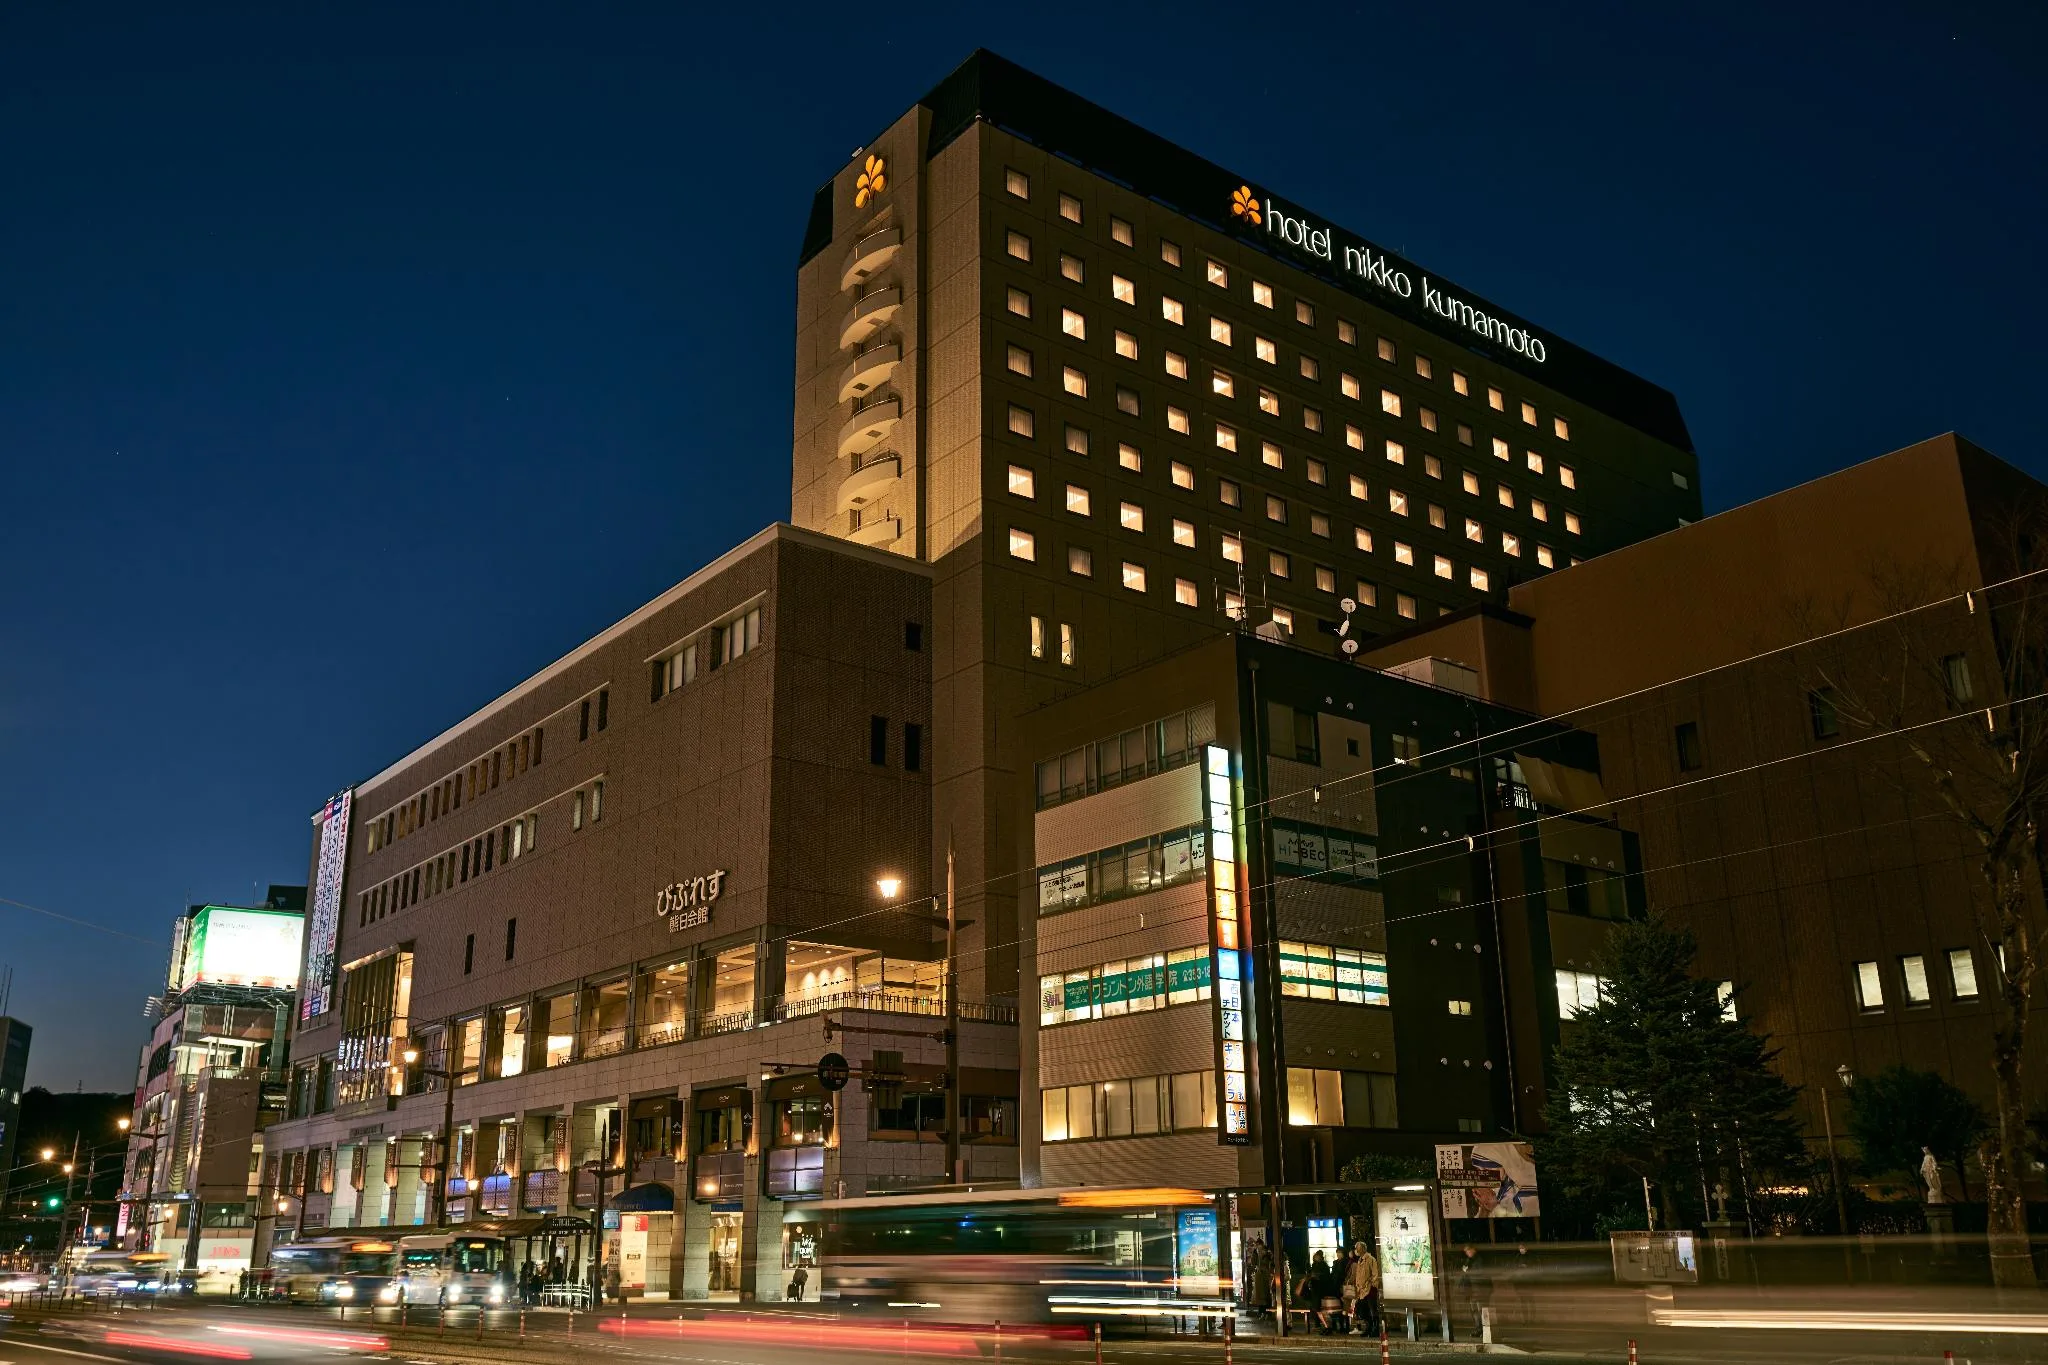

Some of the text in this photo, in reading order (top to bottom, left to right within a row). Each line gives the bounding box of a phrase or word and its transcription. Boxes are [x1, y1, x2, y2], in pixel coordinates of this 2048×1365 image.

[1264, 198, 1547, 363] hotel nikko kumamoto
[657, 869, 726, 917] びぷれす
[669, 906, 709, 933] 熊日会館
[1092, 970, 1178, 1000] ワシントン外語学院
[1222, 999, 1232, 1039] チケット
[210, 1246, 241, 1259] JINS
